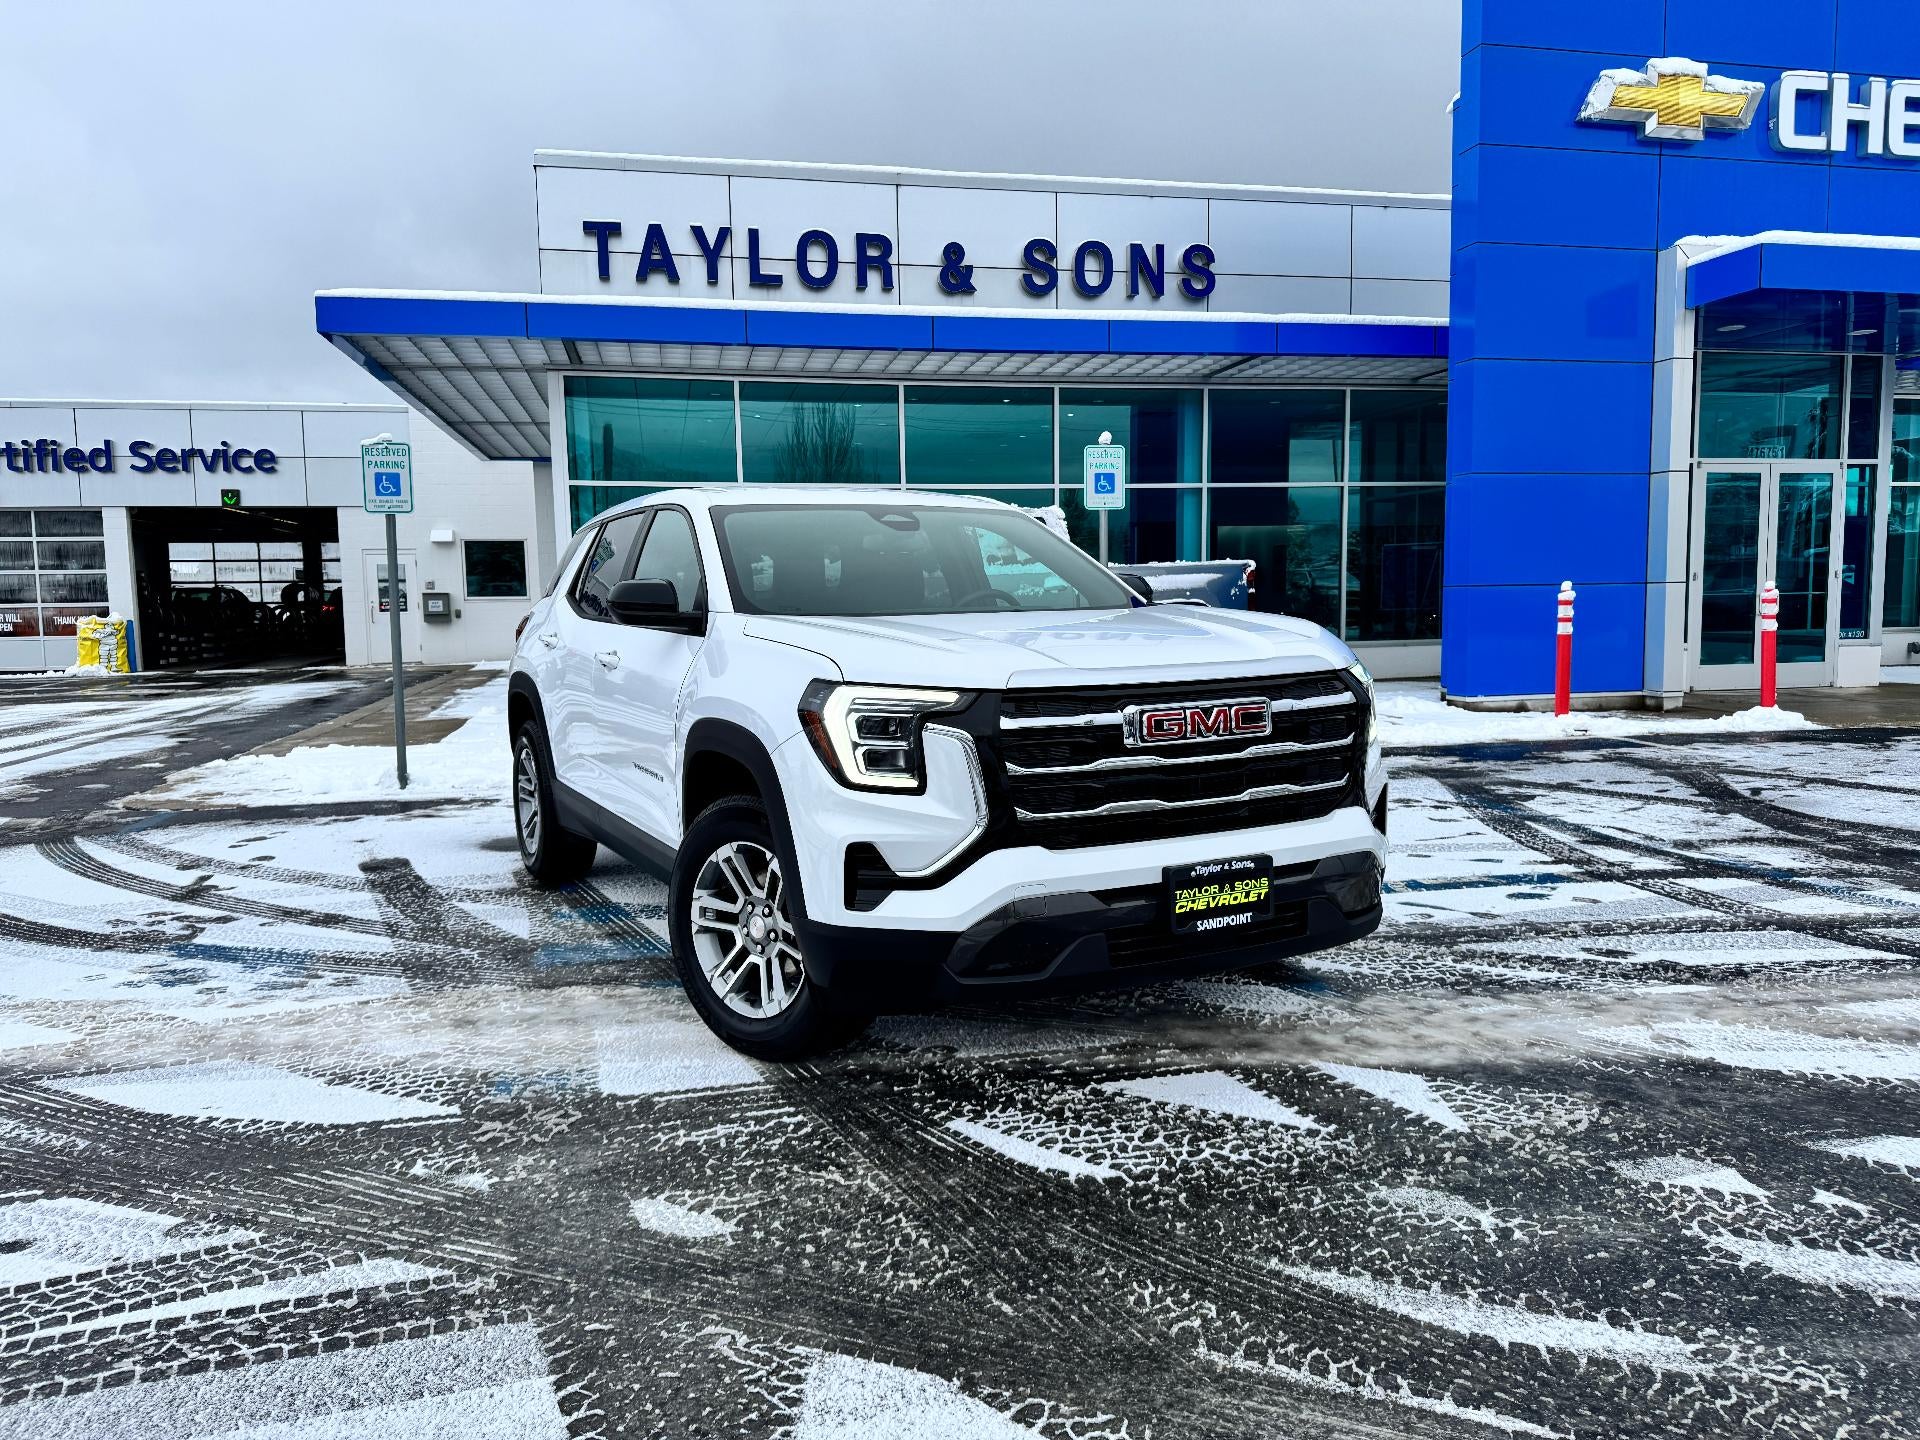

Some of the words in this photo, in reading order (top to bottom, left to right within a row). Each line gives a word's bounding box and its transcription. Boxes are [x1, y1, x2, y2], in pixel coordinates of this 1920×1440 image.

[1770, 71, 1920, 158] CHE
[583, 220, 894, 291] TAYLOR
[938, 241, 977, 295] &
[1020, 238, 1217, 299] SONS
[0, 439, 114, 473] tified
[128, 440, 278, 473] Service
[365, 447, 407, 457] RESERVED
[1088, 450, 1121, 459] RESERVED
[368, 460, 405, 469] PARKING
[1090, 462, 1119, 470] PARKING
[5, 613, 23, 623] WILL
[53, 615, 76, 625] THANK
[1143, 704, 1267, 741] GMC
[1195, 863, 1222, 876] Taylor
[1231, 860, 1251, 870] Sons
[1175, 885, 1219, 899] TAYLOR
[1223, 883, 1230, 894] &
[1234, 877, 1269, 890] SONS
[1175, 889, 1269, 914] CHEVROLET
[1196, 912, 1253, 931] SANDPOINT
